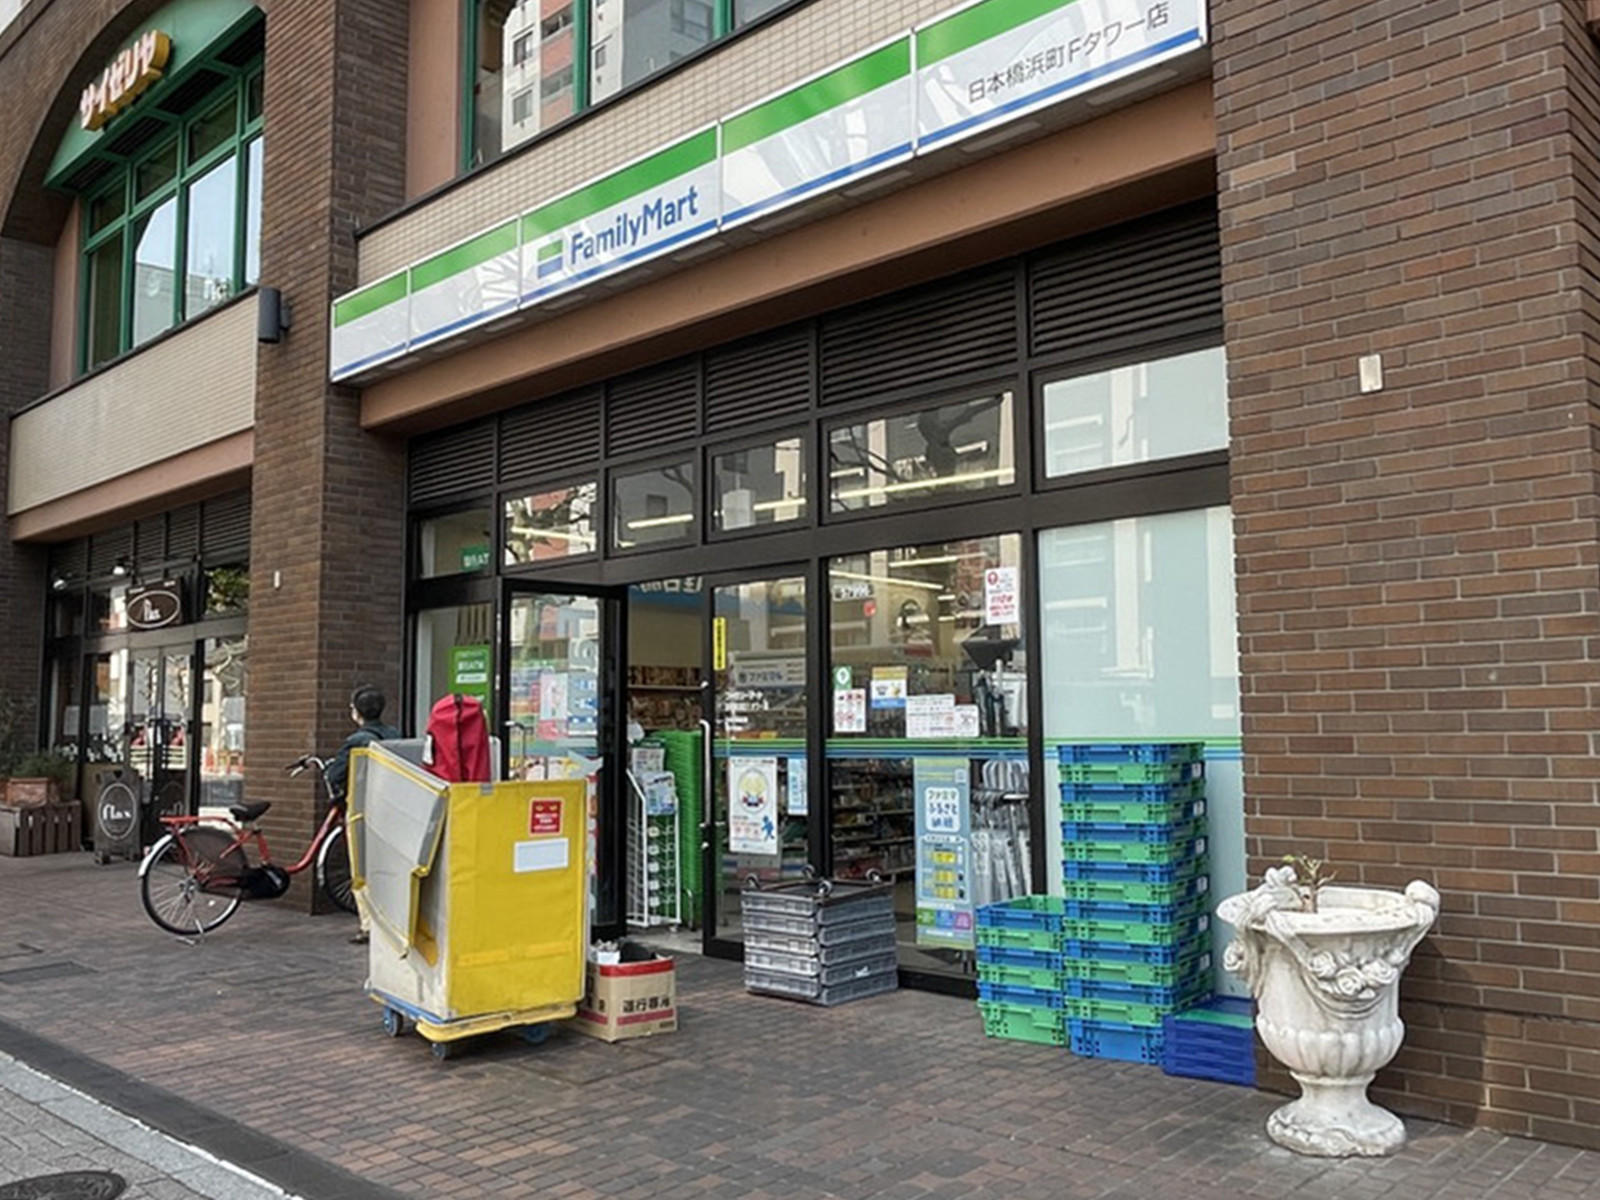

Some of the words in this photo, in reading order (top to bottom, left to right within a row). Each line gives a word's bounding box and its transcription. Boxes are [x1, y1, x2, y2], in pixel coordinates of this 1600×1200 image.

[80, 29, 160, 130] サイゼリヤ
[968, 2, 1169, 103] 日本橋浜町Fタワー店
[570, 185, 698, 264] FamilyMart
[928, 790, 957, 800] ファミマ
